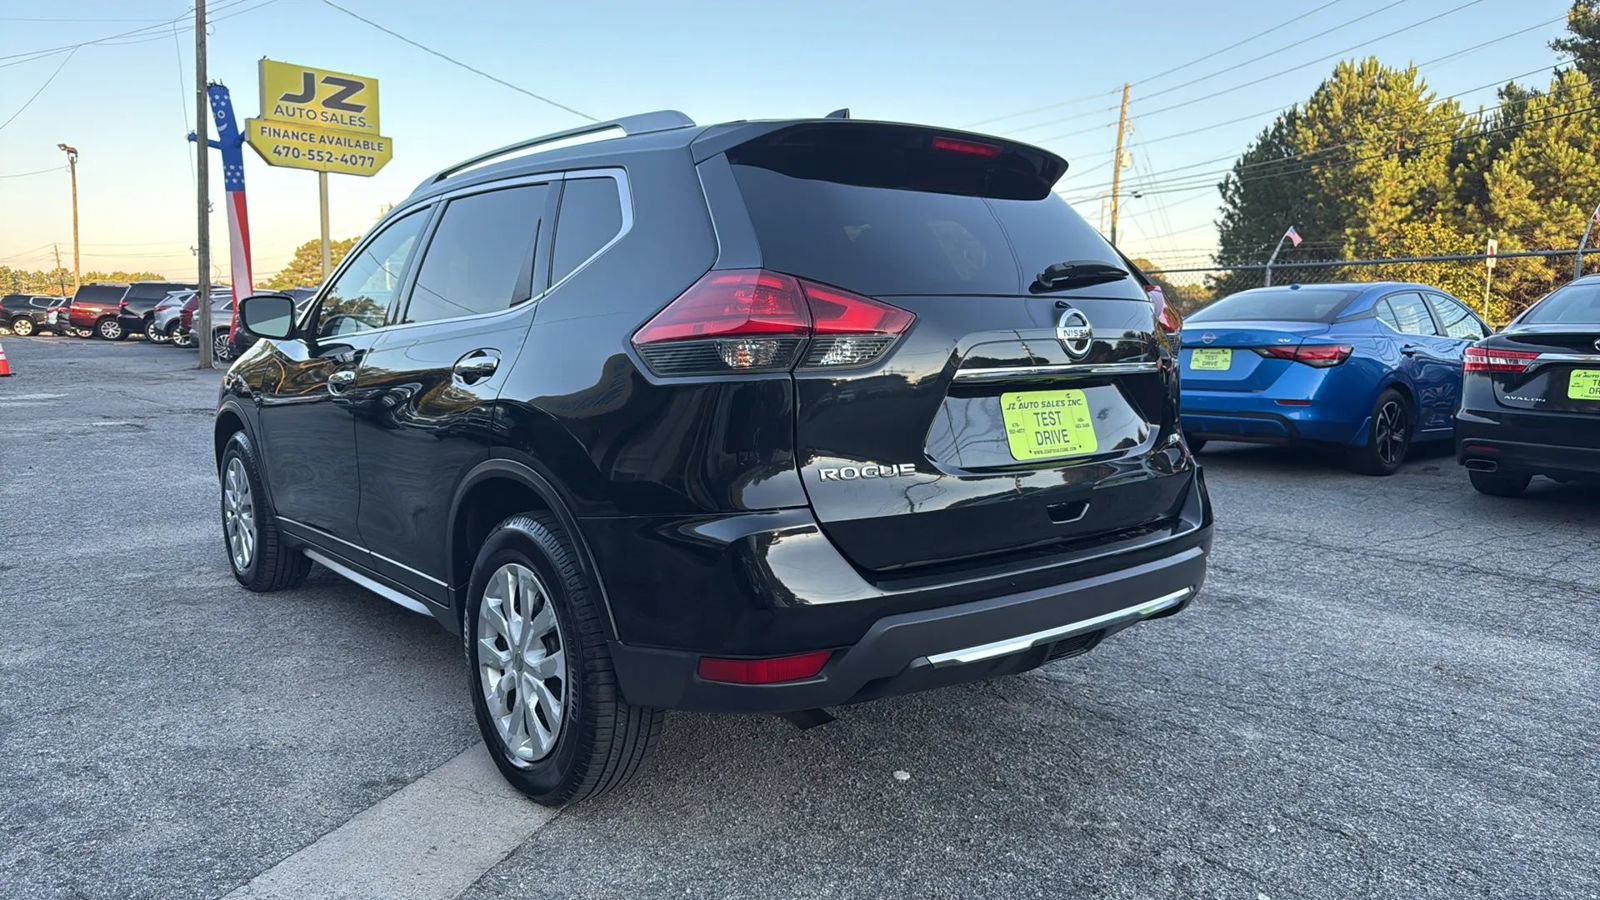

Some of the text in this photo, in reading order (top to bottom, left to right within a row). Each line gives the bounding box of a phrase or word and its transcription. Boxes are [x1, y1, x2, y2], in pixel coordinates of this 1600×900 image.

[279, 71, 367, 113] JZ
[273, 104, 366, 128] AUTO SALES
[260, 126, 384, 152] FINANCE AVAILABLE
[272, 144, 375, 168] 470-552-4077
[1063, 329, 1089, 337] NISSA
[1006, 402, 1016, 410] JZ
[1018, 401, 1039, 409] AUTO
[1041, 400, 1066, 408] SALES
[1033, 411, 1062, 427] TEST
[1035, 429, 1070, 446] DRIVE
[819, 463, 915, 481] ROGUE
